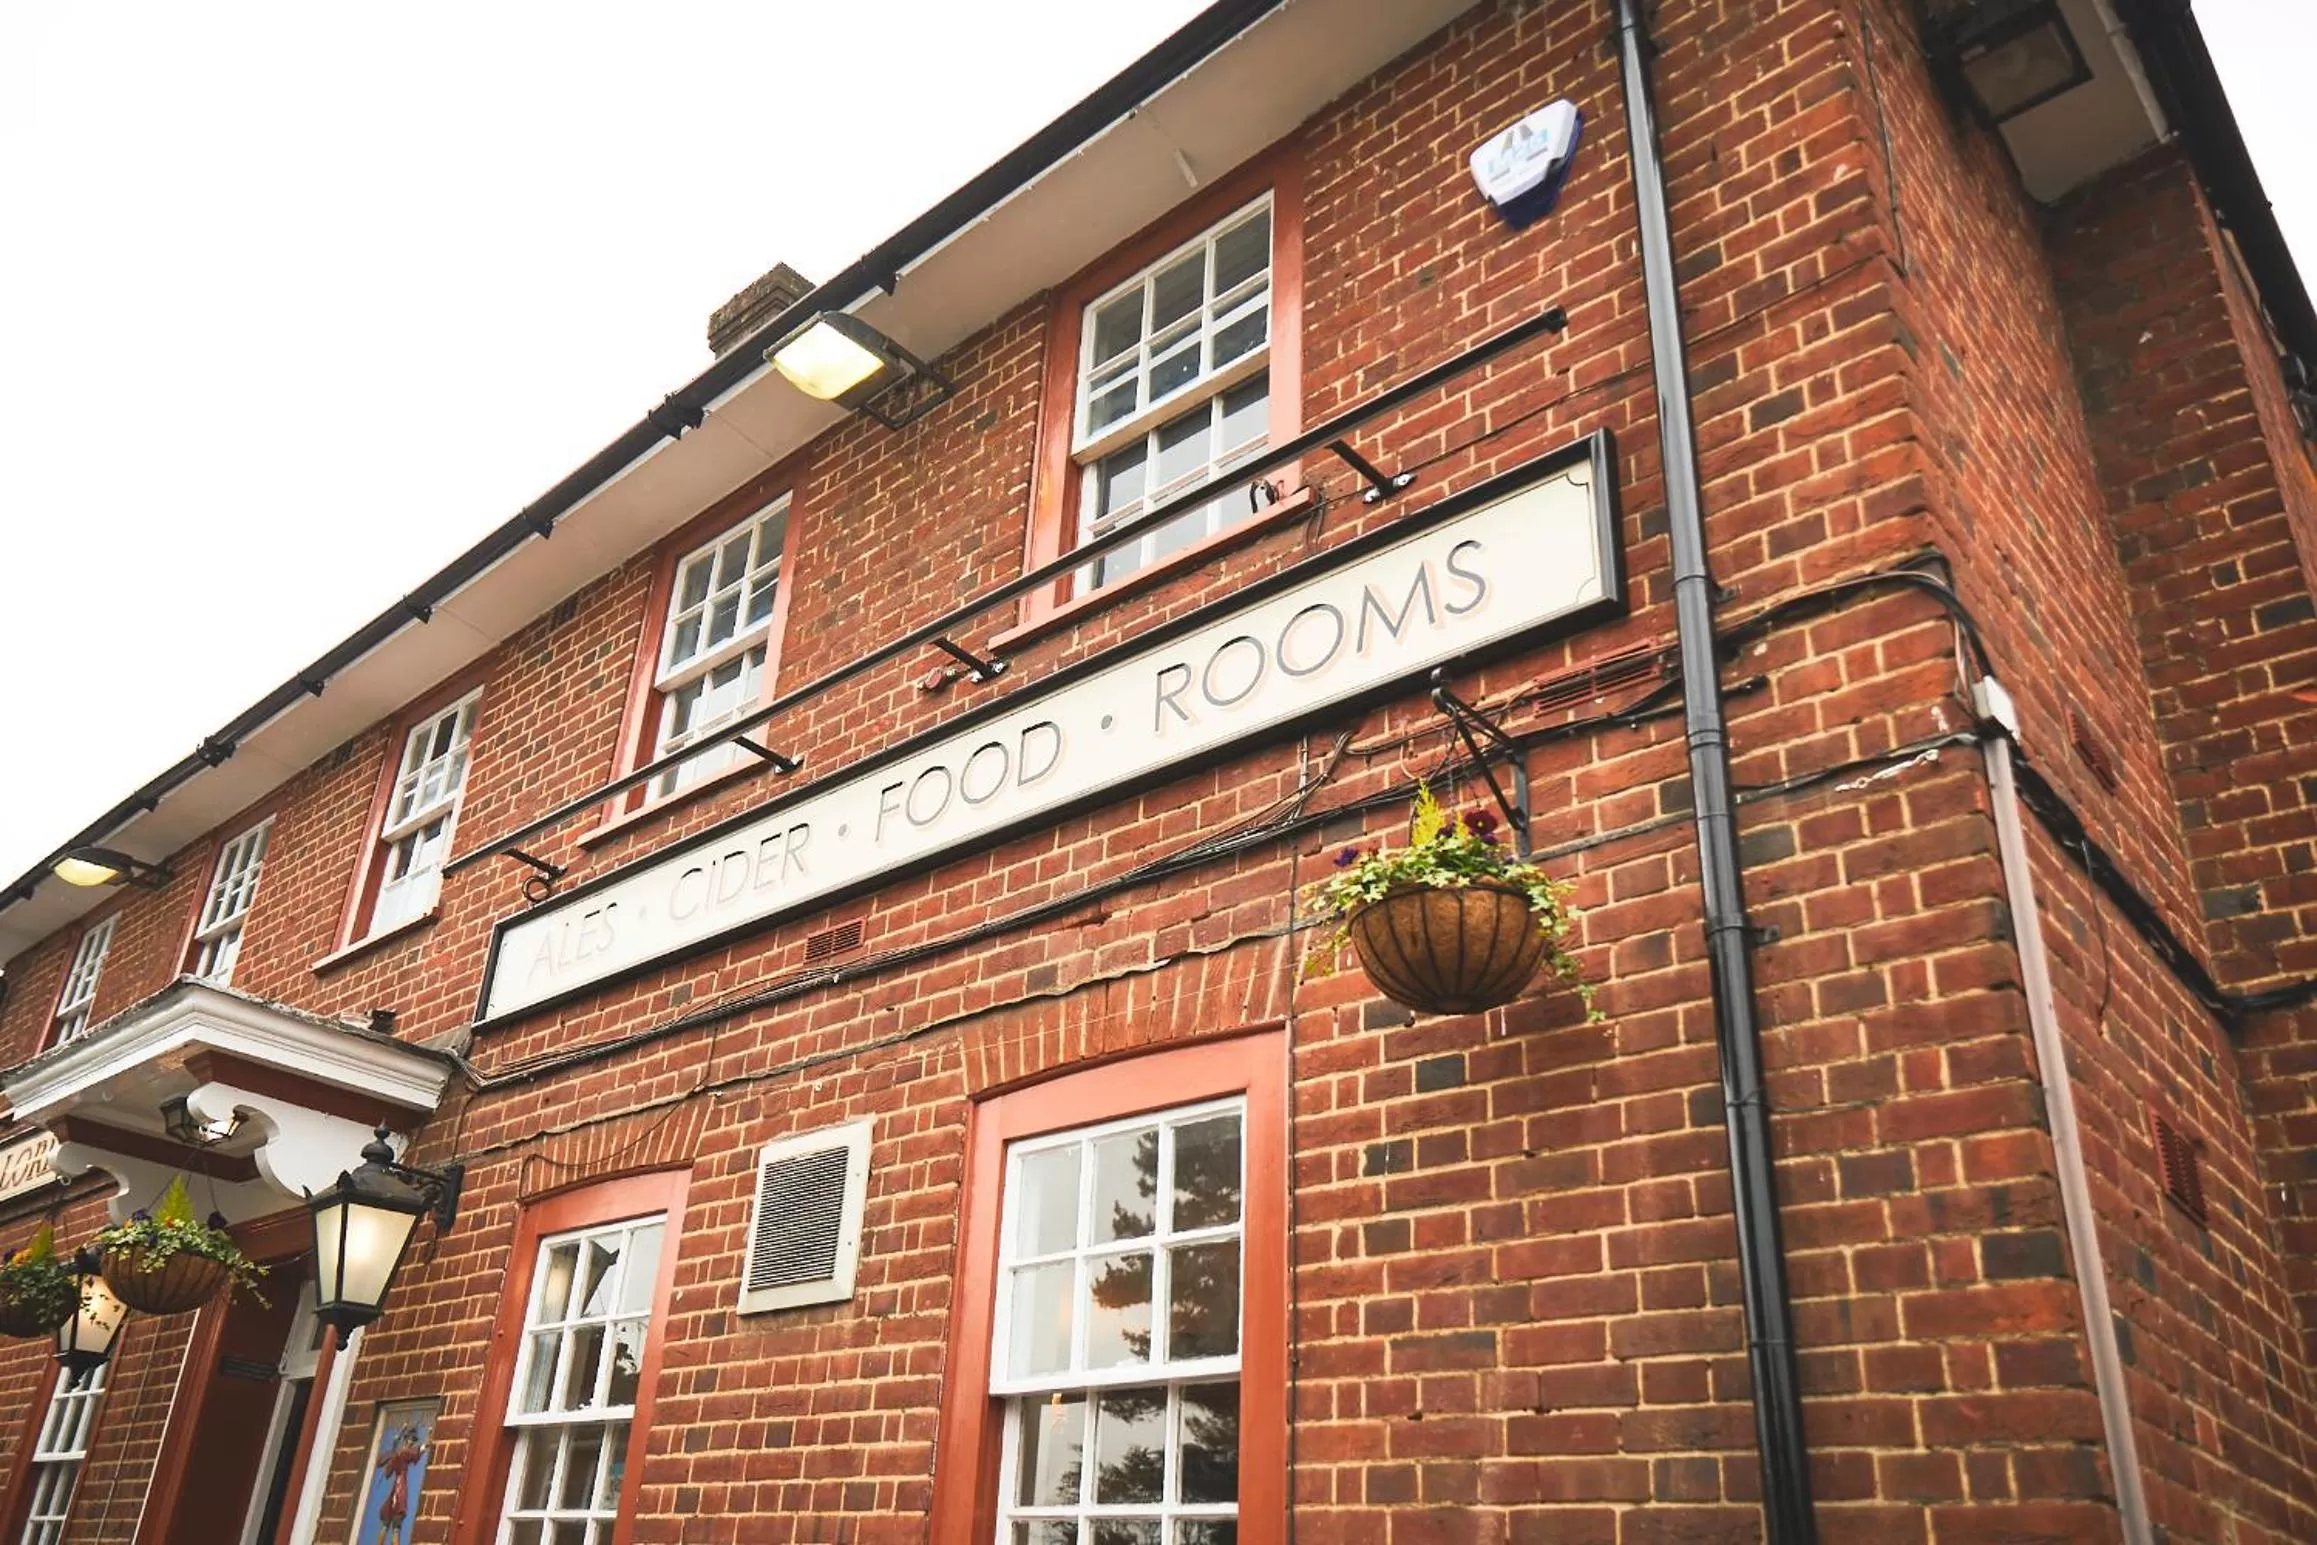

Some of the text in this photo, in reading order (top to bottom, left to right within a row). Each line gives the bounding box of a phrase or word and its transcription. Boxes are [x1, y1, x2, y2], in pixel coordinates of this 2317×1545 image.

[527, 539, 1488, 984] ALES CIDER FOOD ROOMS
